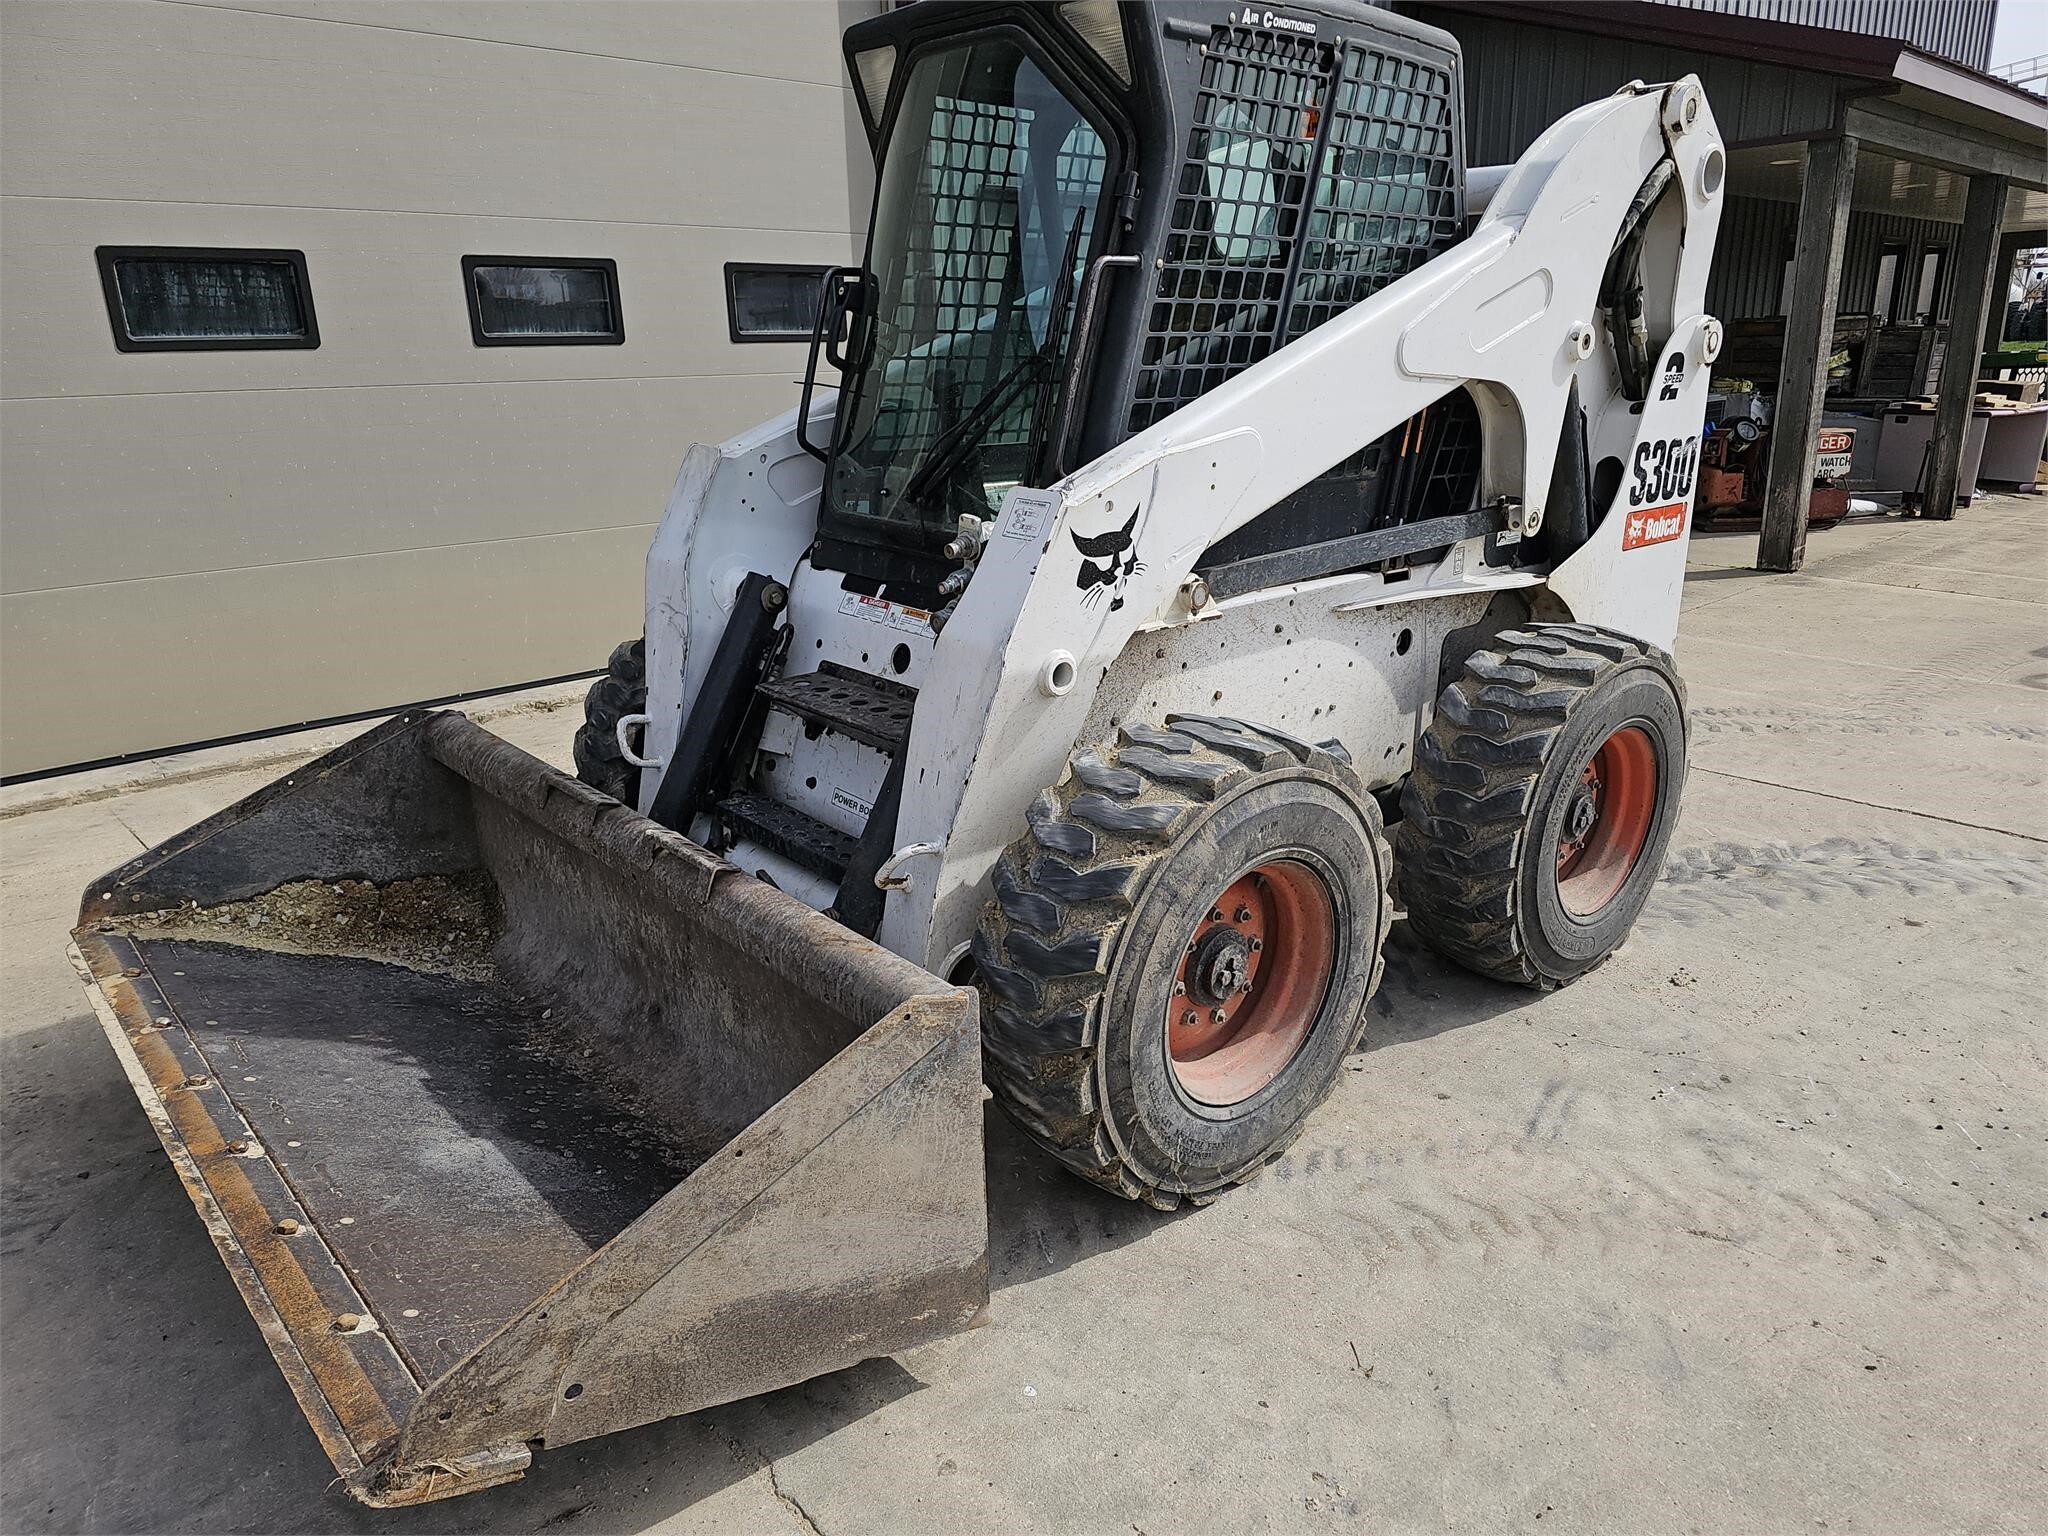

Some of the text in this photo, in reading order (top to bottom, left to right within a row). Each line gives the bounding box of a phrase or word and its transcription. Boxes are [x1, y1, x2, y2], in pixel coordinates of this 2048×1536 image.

[1242, 8, 1316, 33] AIR CONDITIONED
[1663, 373, 1684, 384] SPEED
[1820, 436, 1846, 449] GER
[1821, 456, 1850, 467] WATCH
[1630, 436, 1697, 506] S300
[1645, 515, 1681, 541] Bobcat
[834, 793, 858, 810] POWER
